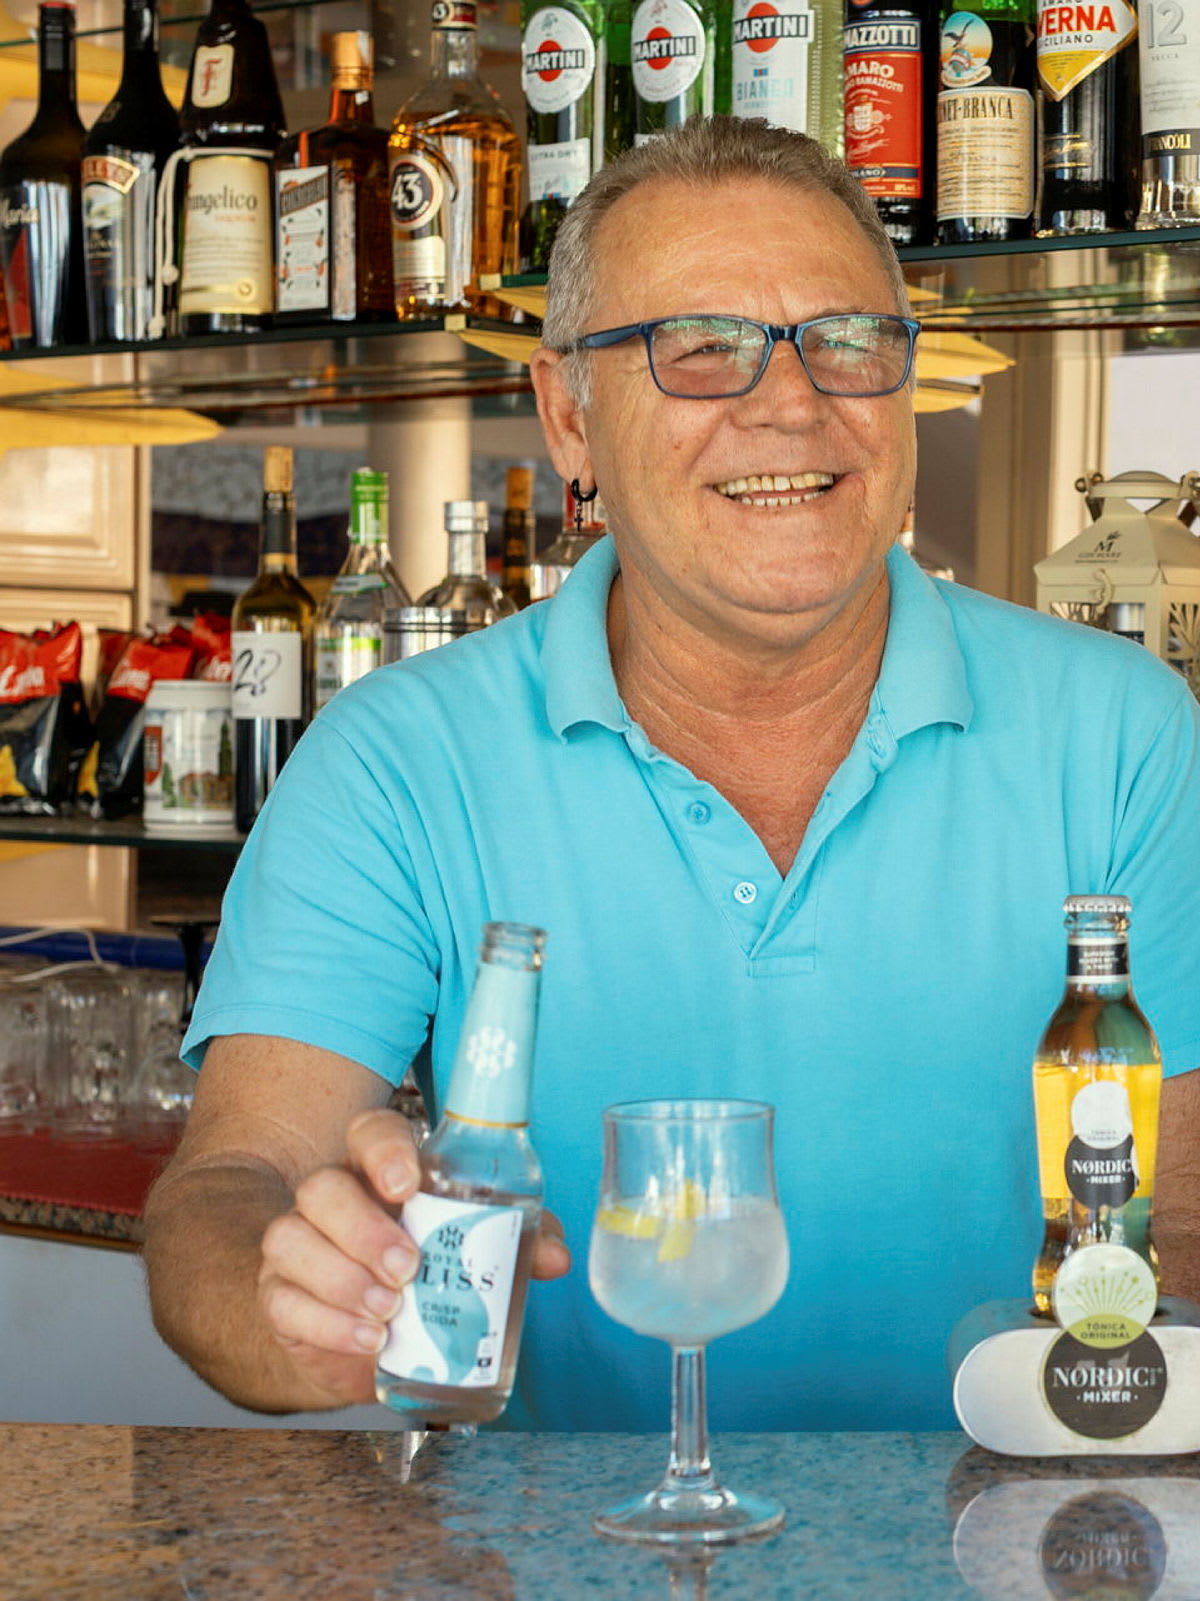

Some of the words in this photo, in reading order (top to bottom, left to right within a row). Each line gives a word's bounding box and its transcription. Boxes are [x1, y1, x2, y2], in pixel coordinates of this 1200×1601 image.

[735, 16, 806, 41] MARTINI
[634, 37, 695, 61] MARTINI
[527, 50, 584, 73] MARTINI
[392, 172, 421, 209] 43
[422, 1265, 494, 1292] LISS
[422, 1302, 461, 1314] CRISP
[422, 1314, 459, 1328] SODA
[1083, 1391, 1132, 1403] MIXER
